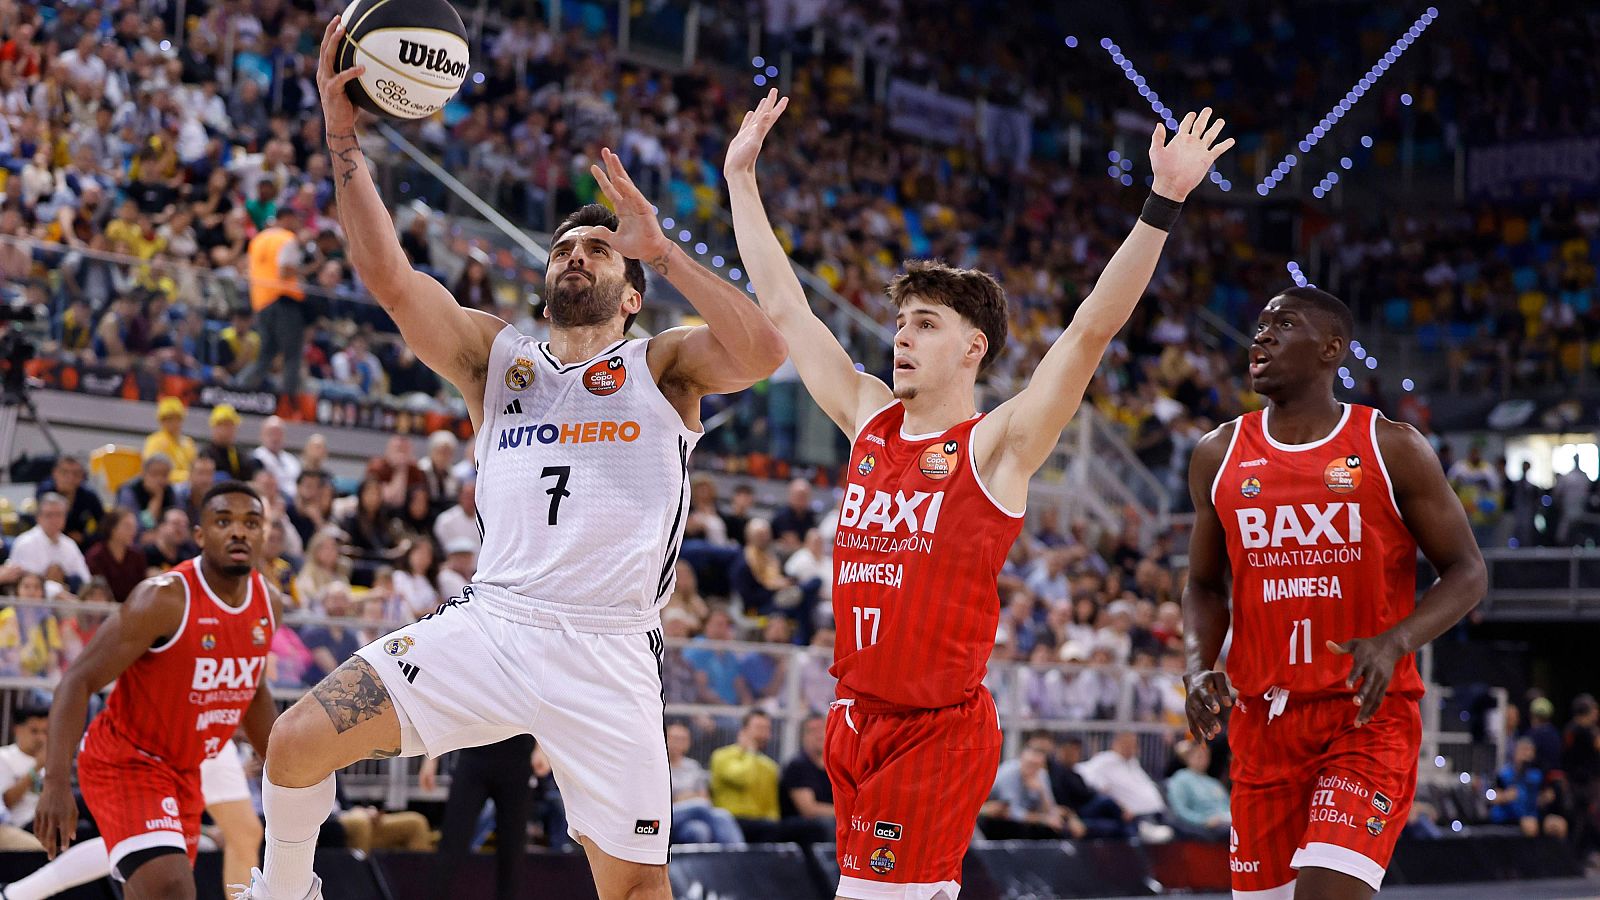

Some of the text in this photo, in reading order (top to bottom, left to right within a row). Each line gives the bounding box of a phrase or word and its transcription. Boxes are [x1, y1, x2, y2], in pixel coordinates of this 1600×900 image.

[398, 38, 467, 79] Wilson
[375, 79, 410, 106] Copa
[388, 80, 407, 96] acb
[590, 374, 613, 382] Copa
[497, 420, 641, 451] AUTOHERO
[540, 466, 571, 526] 7
[840, 482, 945, 534] BAXI
[1235, 502, 1362, 550] BAXI
[1247, 546, 1362, 568] CLIMATIZACIÓN
[1263, 575, 1343, 603] MANRESA
[852, 606, 881, 651] 17
[1289, 618, 1313, 665] 11
[1311, 789, 1336, 807] ETL
[636, 825, 655, 834] acb
[850, 814, 871, 833] sio
[876, 828, 896, 838] acb
[1229, 855, 1260, 873] abor
